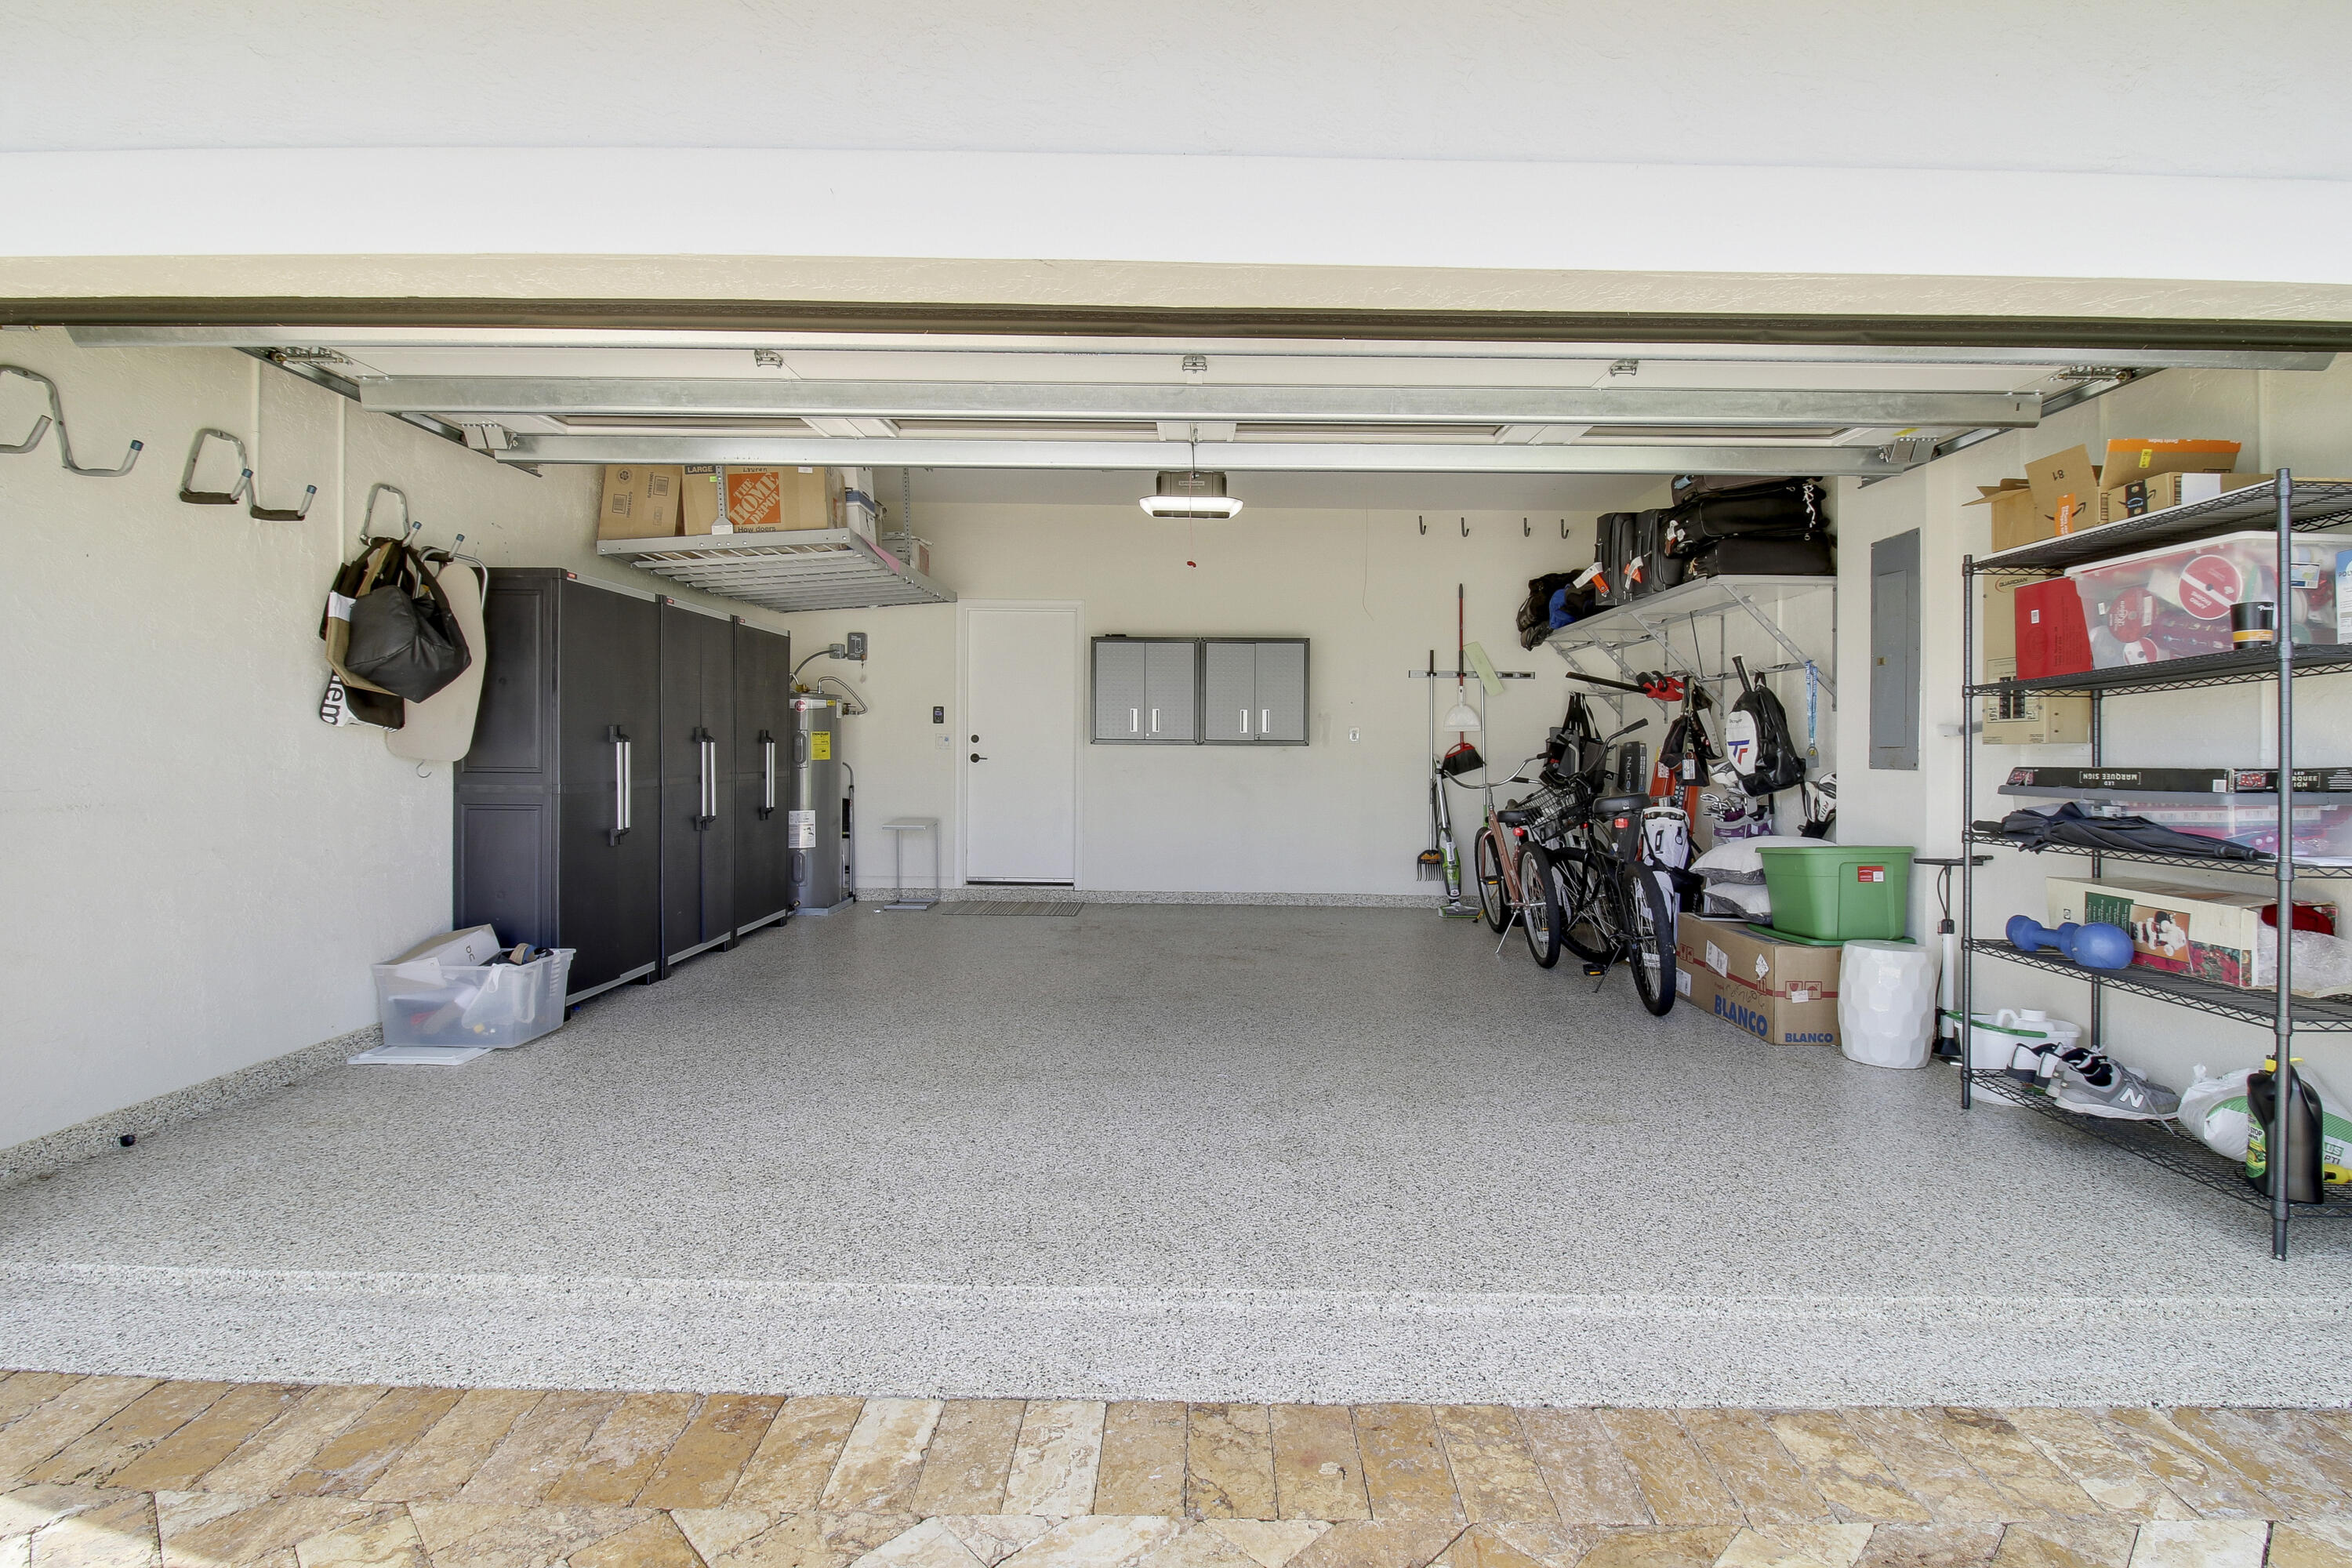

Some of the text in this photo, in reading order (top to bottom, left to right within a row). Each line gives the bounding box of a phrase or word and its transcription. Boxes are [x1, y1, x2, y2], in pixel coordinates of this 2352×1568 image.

[729, 473, 779, 525] HOME
[733, 478, 755, 499] THE
[749, 490, 779, 524] DEPOT
[1714, 994, 1768, 1036] BLANCO
[1785, 1033, 1834, 1043] BLANCO
[2119, 1087, 2144, 1108] N
